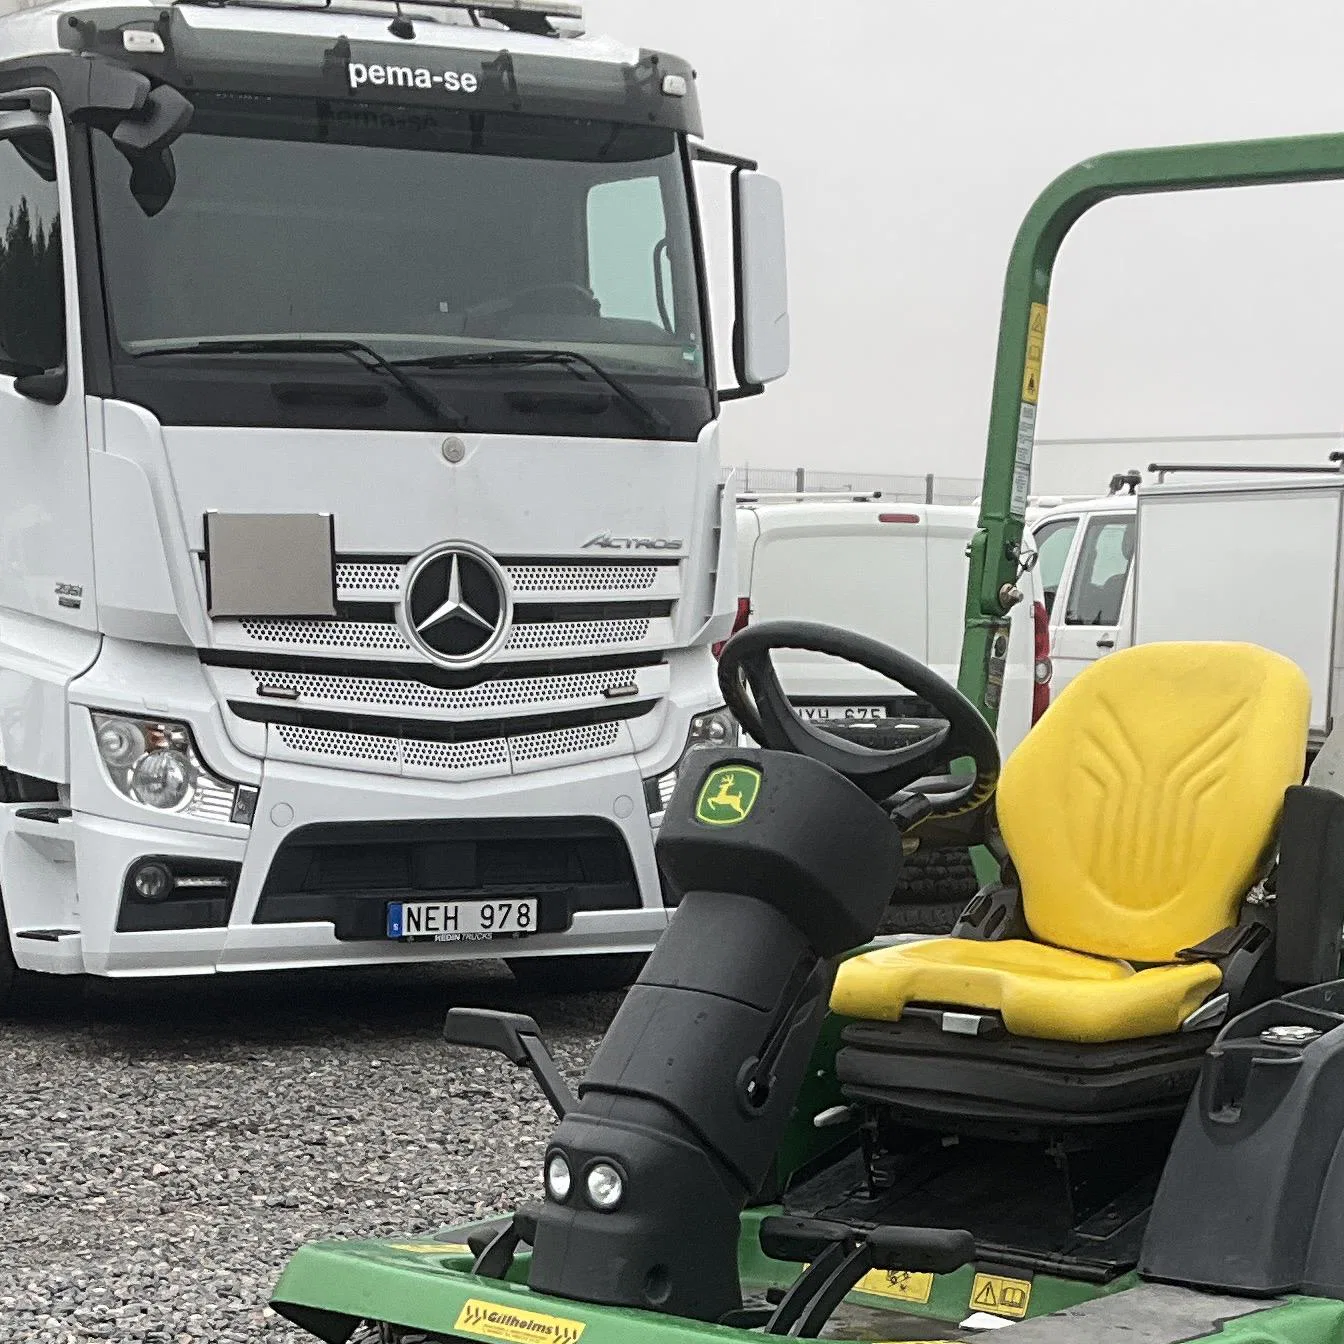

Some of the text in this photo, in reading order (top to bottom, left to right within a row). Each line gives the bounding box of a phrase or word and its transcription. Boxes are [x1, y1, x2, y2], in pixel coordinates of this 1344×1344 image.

[348, 62, 478, 93] pema-se
[579, 530, 683, 549] ACTROS
[406, 903, 531, 932] NEH 978
[487, 1311, 554, 1336] Gillholms
